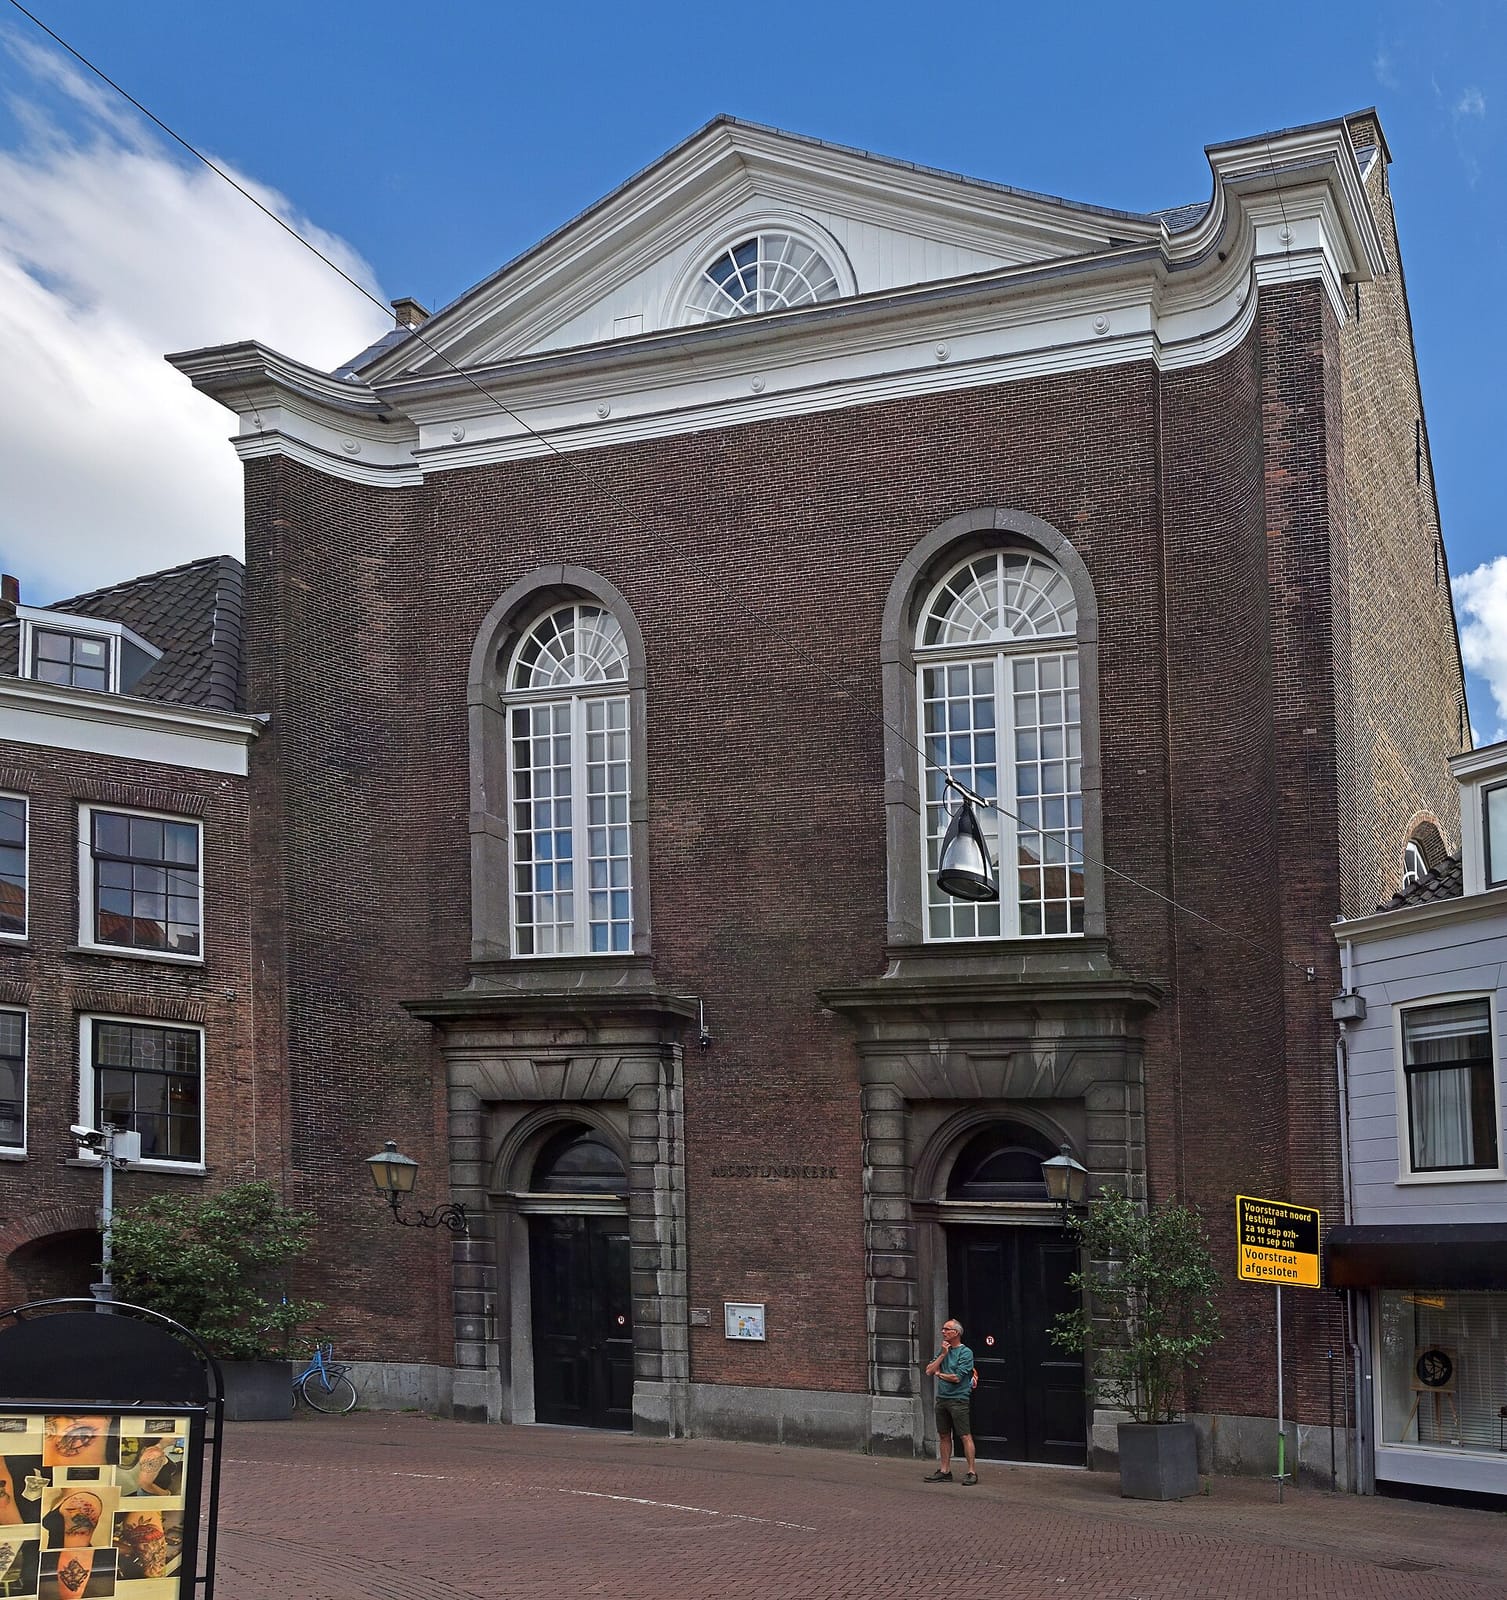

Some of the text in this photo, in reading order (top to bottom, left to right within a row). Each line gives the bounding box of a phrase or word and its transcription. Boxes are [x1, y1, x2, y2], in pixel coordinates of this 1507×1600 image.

[1244, 1202, 1312, 1222] Voorstraat noord
[1245, 1213, 1276, 1226] festival
[1245, 1224, 1255, 1233] za
[1256, 1226, 1265, 1234] 10
[1267, 1229, 1281, 1238] sep
[1245, 1235, 1295, 1248] zo 11 sep 01h
[1245, 1248, 1297, 1265] Voorstraat
[1245, 1263, 1298, 1278] afgesloten
